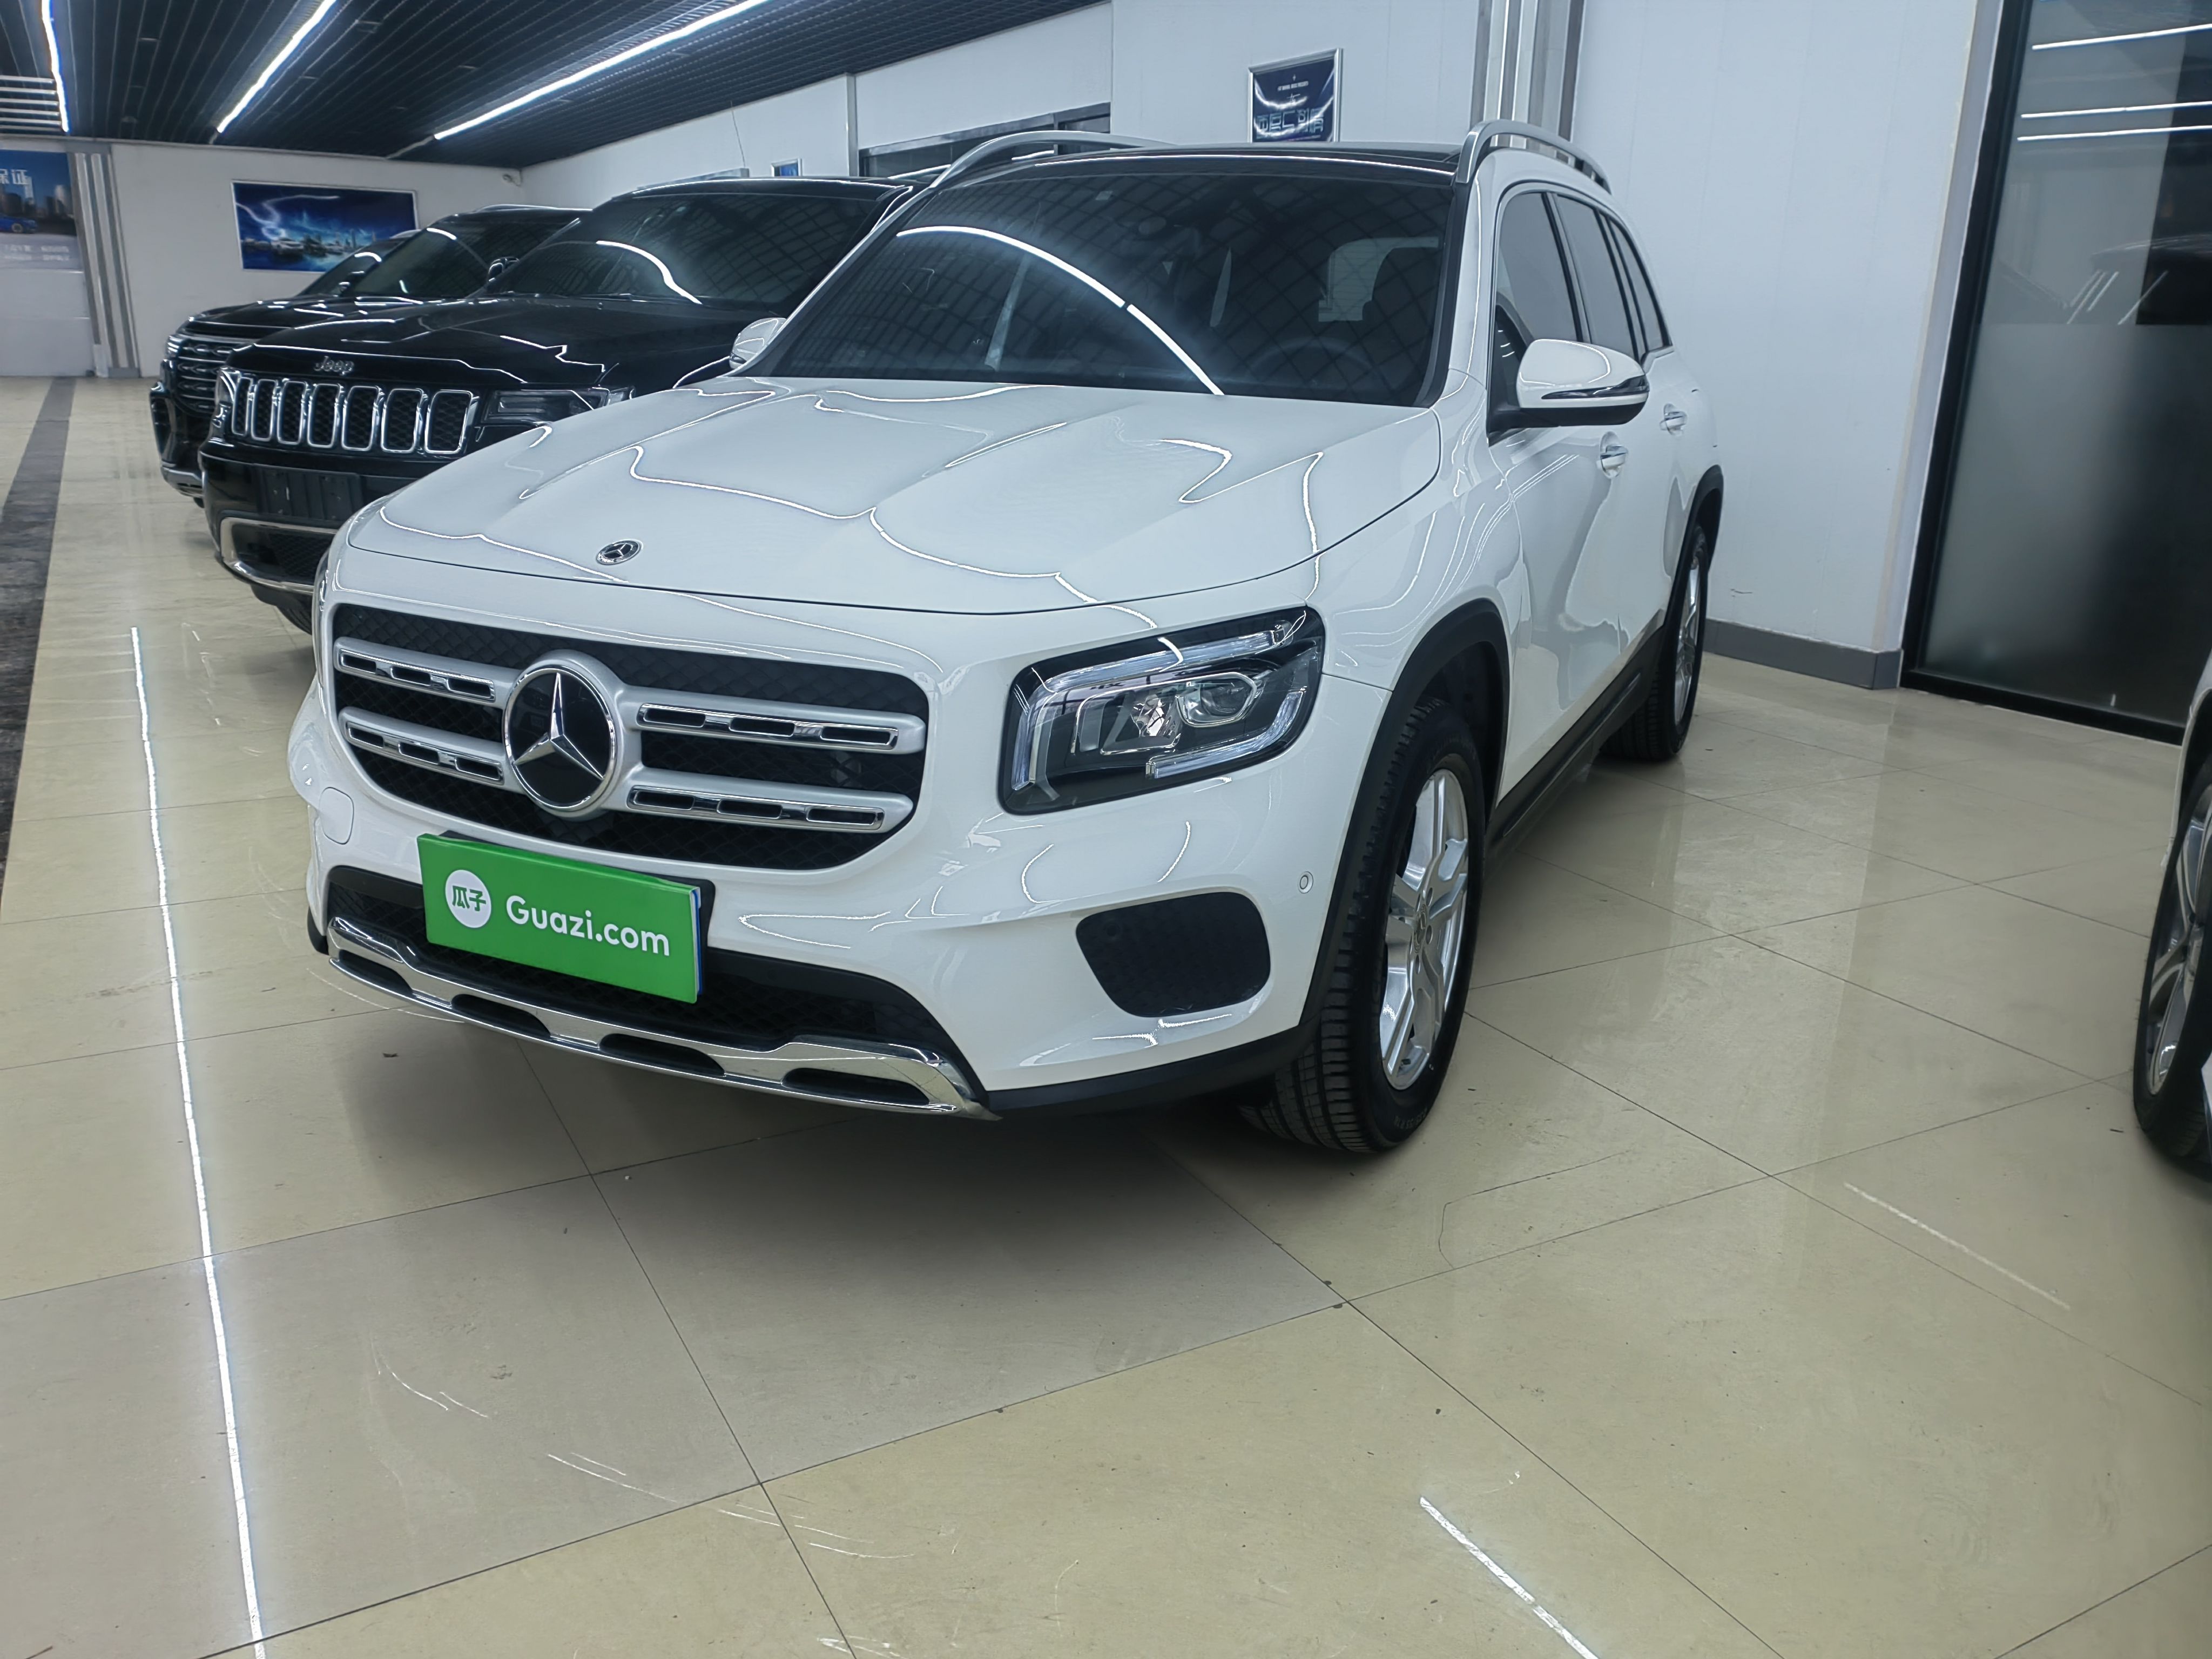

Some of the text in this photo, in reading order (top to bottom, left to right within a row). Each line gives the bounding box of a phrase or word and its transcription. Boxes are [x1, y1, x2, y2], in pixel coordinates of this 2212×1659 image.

[314, 356, 354, 375] Jeep
[452, 885, 487, 912] 瓜子
[506, 895, 670, 956] Guazi.com
